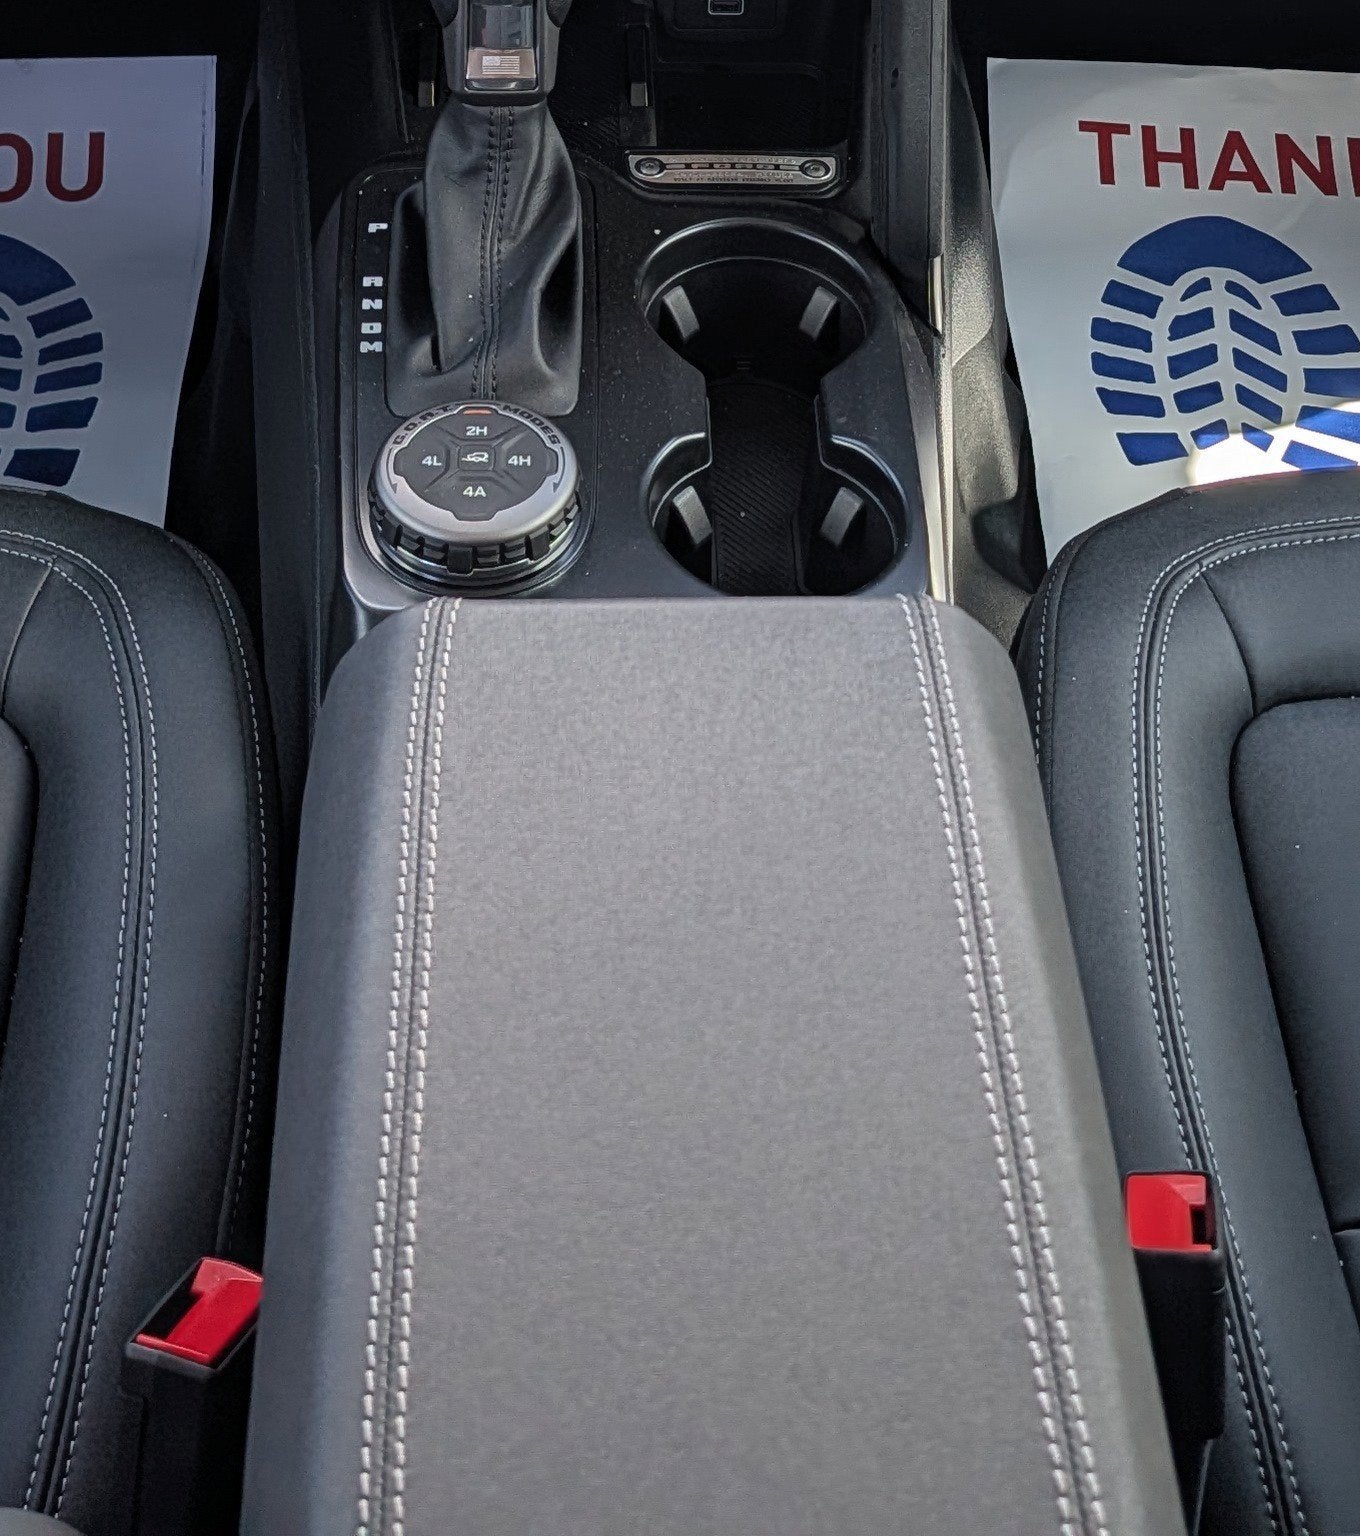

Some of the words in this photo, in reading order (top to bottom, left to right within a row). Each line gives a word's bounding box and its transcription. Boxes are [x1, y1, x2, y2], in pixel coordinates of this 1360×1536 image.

[367, 222, 388, 233] P
[362, 298, 383, 310] N
[360, 340, 383, 354] M
[503, 404, 561, 445] MODES
[465, 426, 488, 437] 2H
[421, 455, 442, 467] 4L
[507, 455, 531, 466] 4H
[462, 486, 487, 498] 4A
